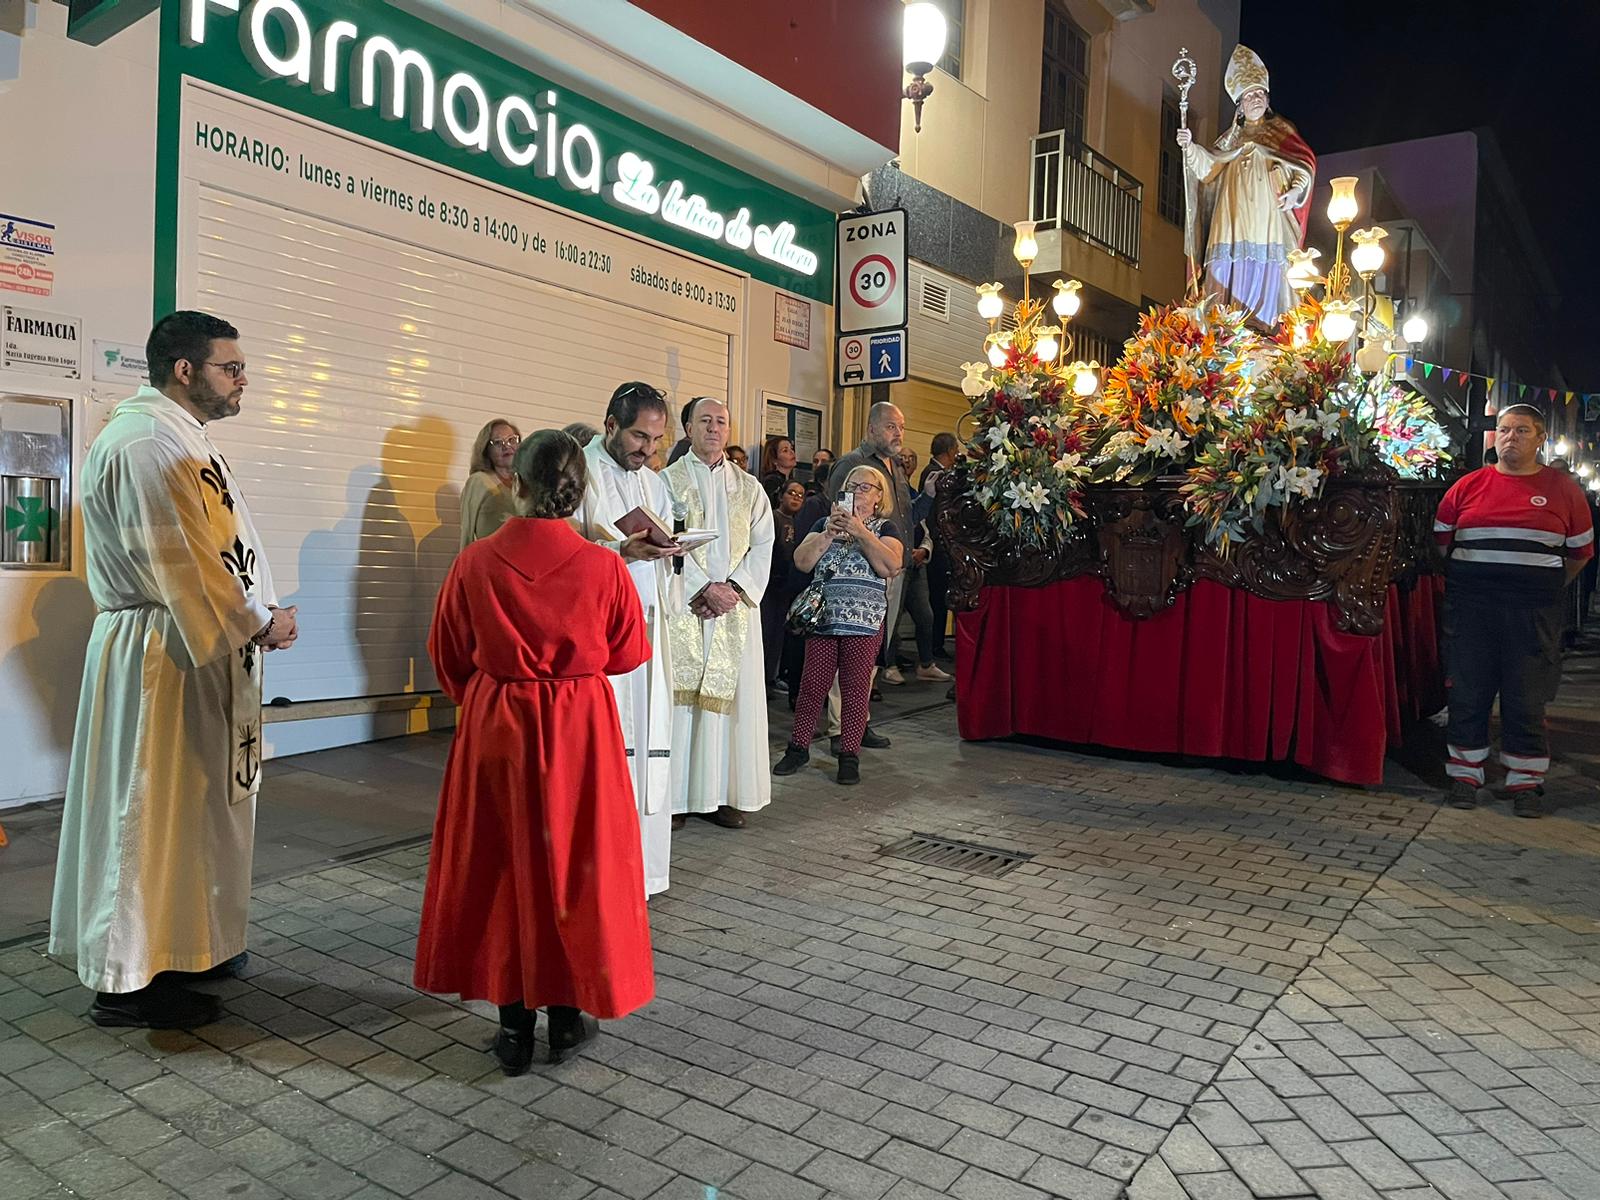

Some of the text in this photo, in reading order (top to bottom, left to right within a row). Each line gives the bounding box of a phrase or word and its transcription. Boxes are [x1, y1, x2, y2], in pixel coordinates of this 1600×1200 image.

[613, 152, 660, 214] La
[661, 180, 724, 240] botica
[725, 207, 753, 250] de
[196, 121, 736, 312] HORARIO: lunes a viernes de 8:30 a 14:00 y de 16:00 a 22:30 sábados de 9:00 a 13:30
[16, 231, 52, 245] VISOR
[846, 221, 897, 242] ZONA
[860, 271, 886, 291] 30
[6, 315, 77, 341] FARMACIA
[849, 346, 859, 354] 30
[870, 336, 901, 345] PRIORIDAD
